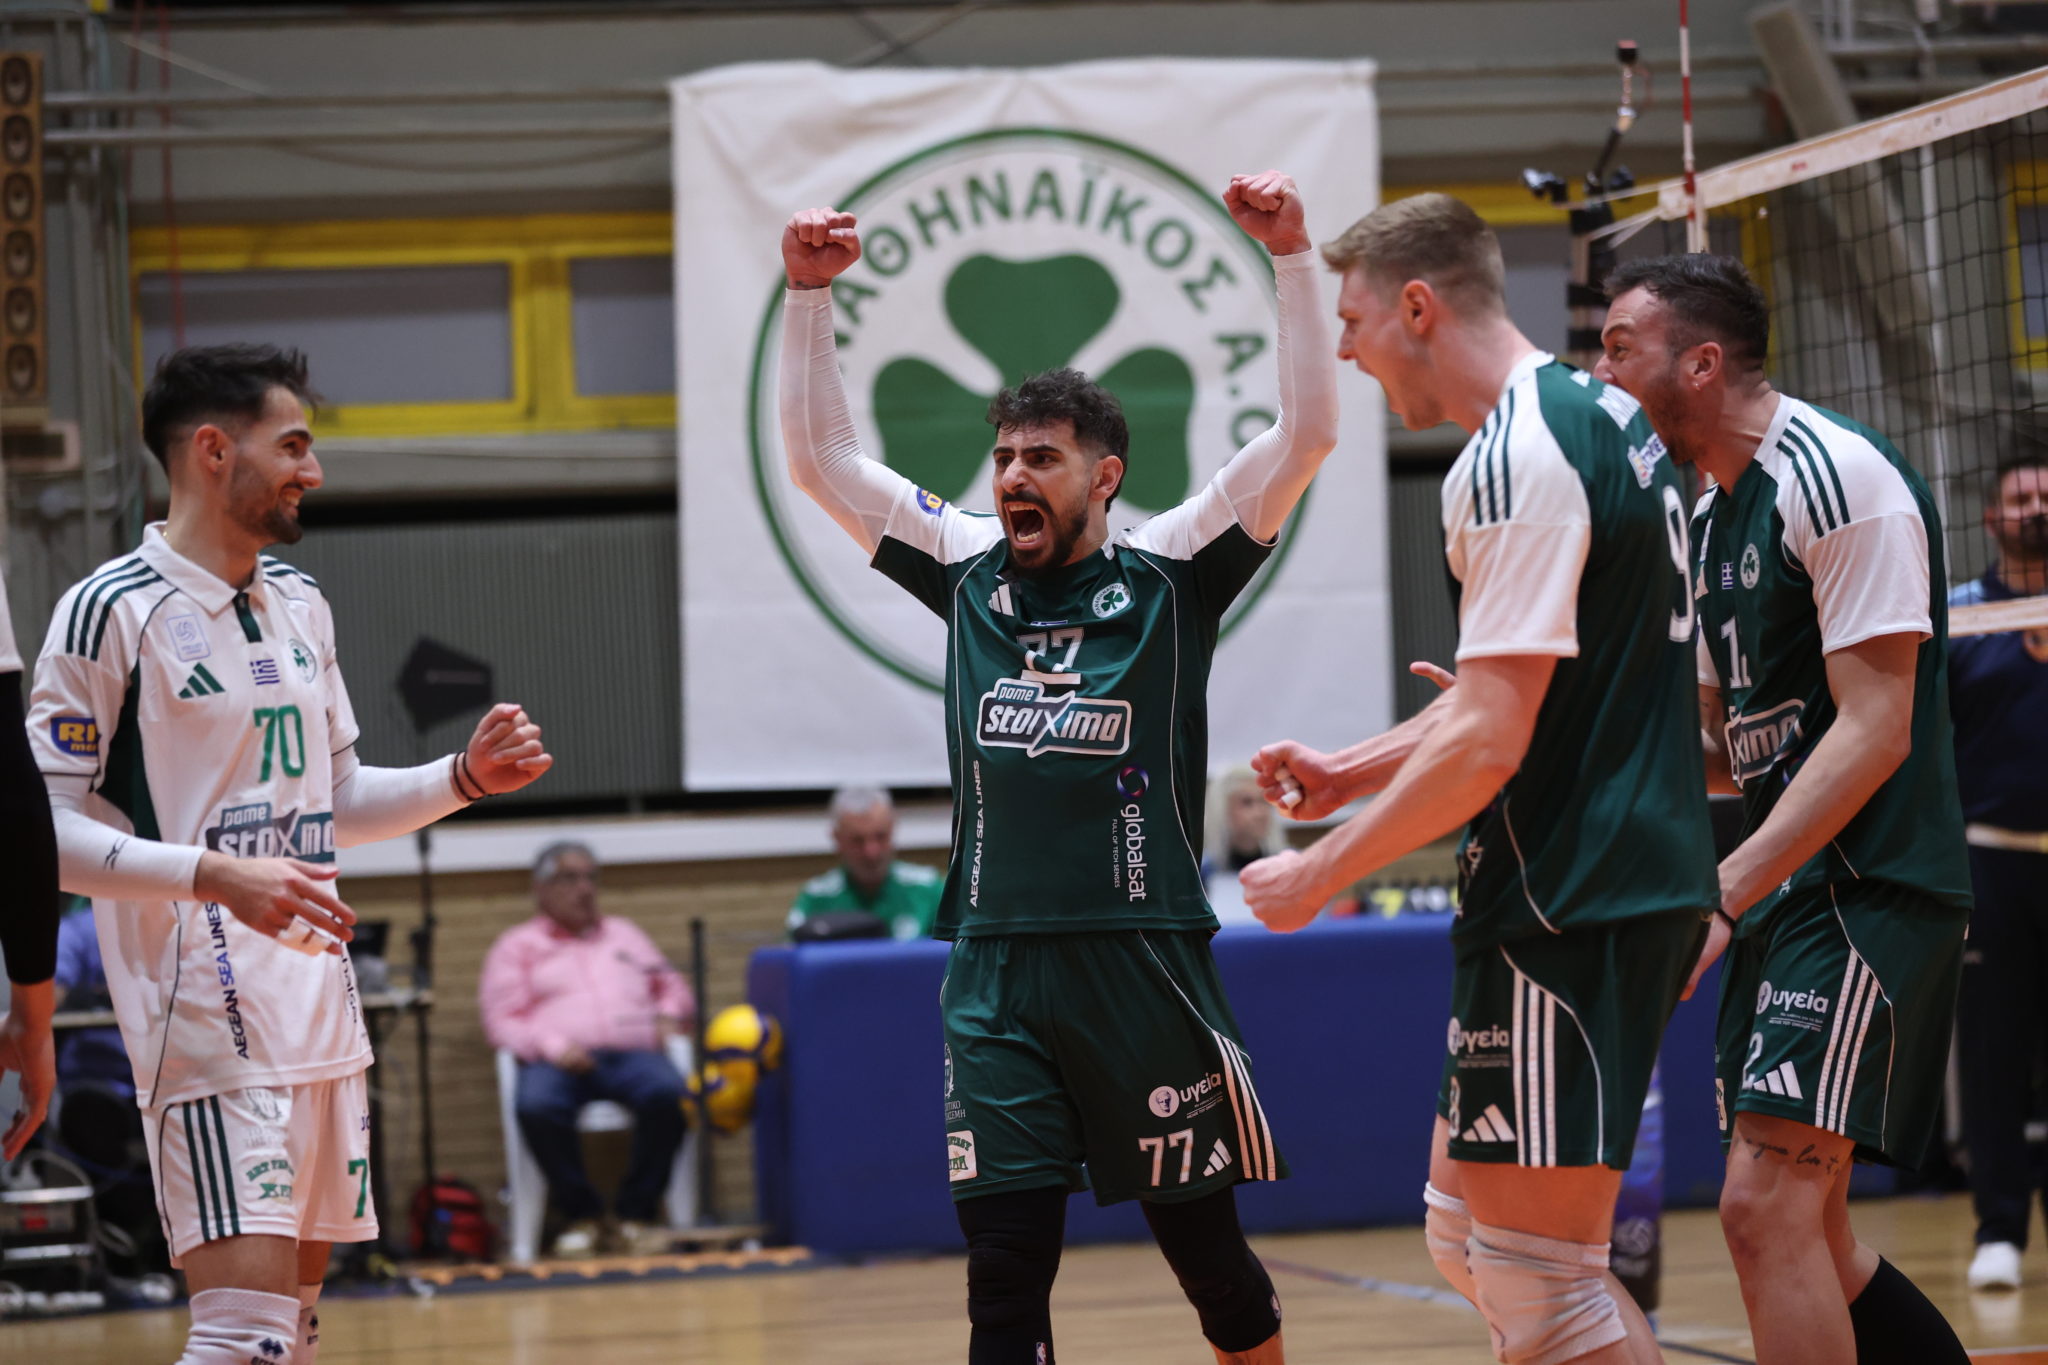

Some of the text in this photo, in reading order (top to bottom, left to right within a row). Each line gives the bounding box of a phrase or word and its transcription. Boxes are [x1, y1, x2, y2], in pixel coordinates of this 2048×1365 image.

[1016, 627, 1085, 674] 77
[998, 686, 1035, 702] pame
[253, 705, 305, 783] 70
[223, 805, 267, 829] pame
[970, 759, 984, 908] AEGEAN SEA LINES
[1120, 803, 1147, 902] globalsat
[205, 900, 250, 1060] AEGEAN SEA LINES
[1138, 1127, 1195, 1187] 77
